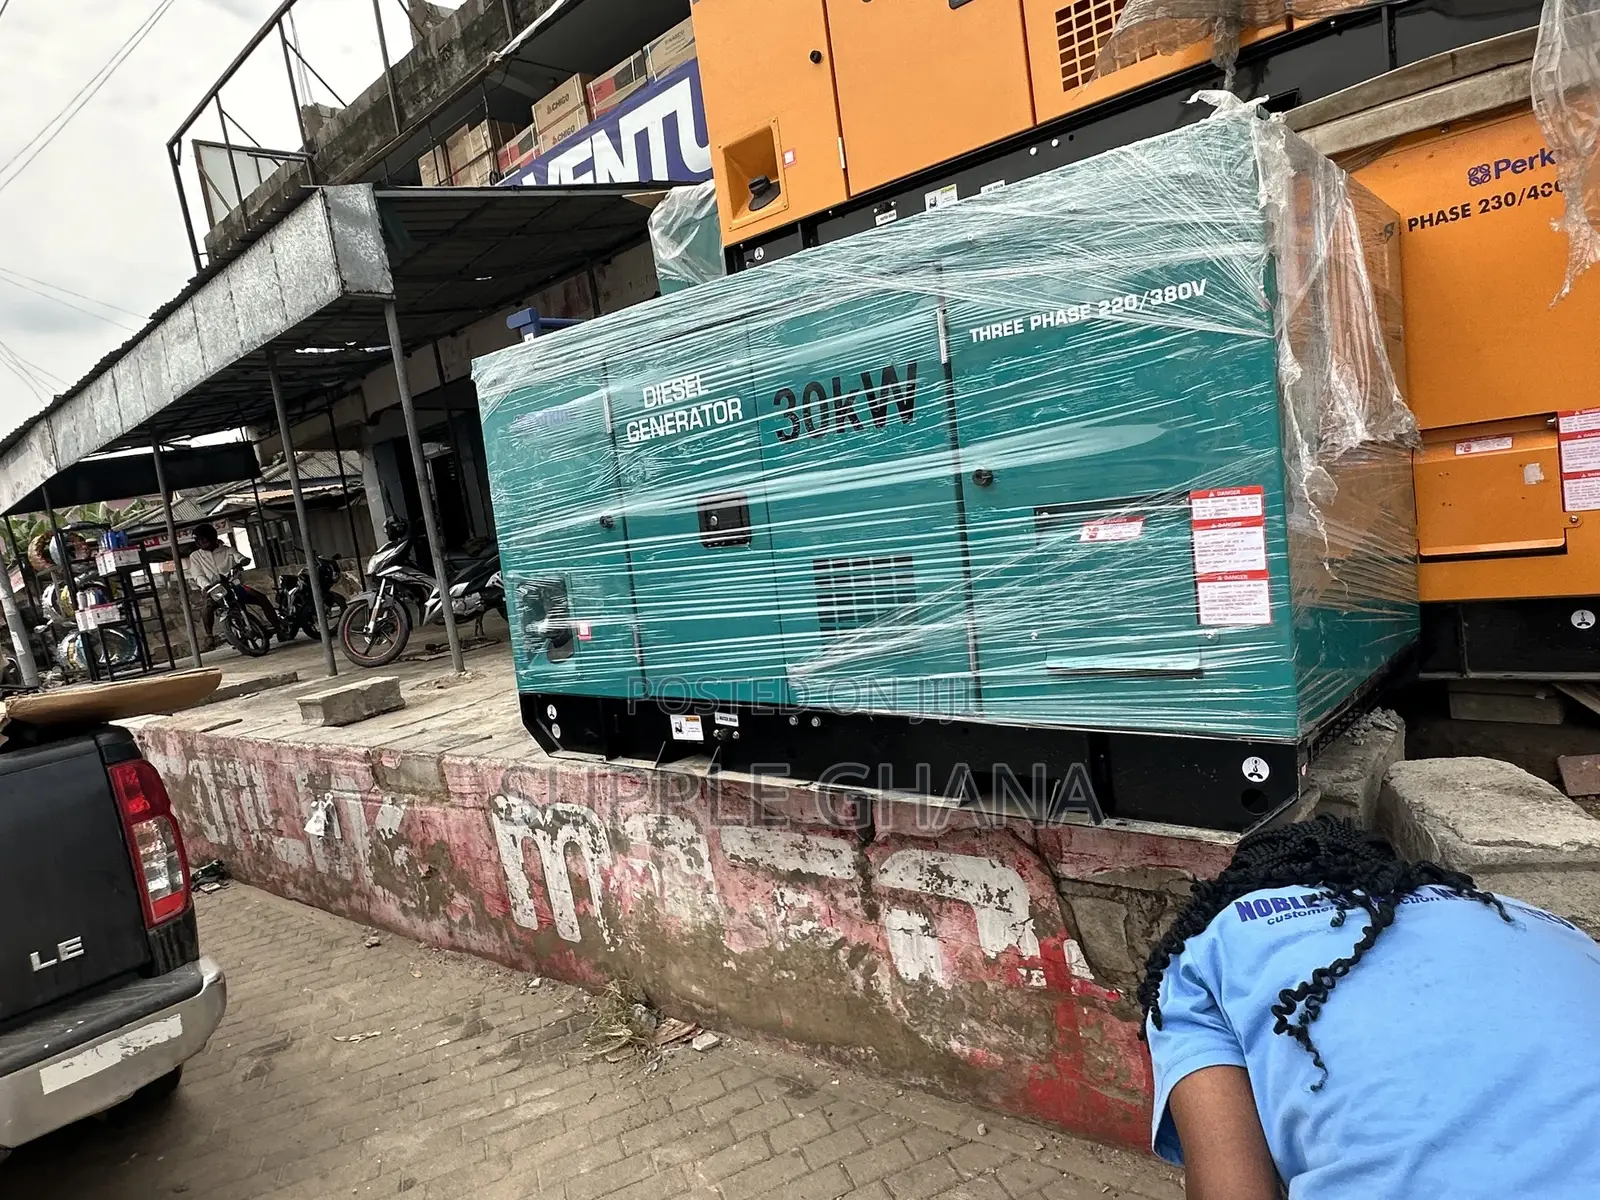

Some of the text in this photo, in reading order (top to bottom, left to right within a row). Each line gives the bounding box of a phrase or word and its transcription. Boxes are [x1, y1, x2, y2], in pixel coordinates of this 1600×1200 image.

[1407, 202, 1472, 232] PHASE
[969, 279, 1207, 343] THREE PHASE 220/380V
[643, 373, 709, 408] DIESEL
[773, 361, 918, 444] 30kW
[626, 397, 743, 443] GENERATOR
[30, 936, 84, 972] LE
